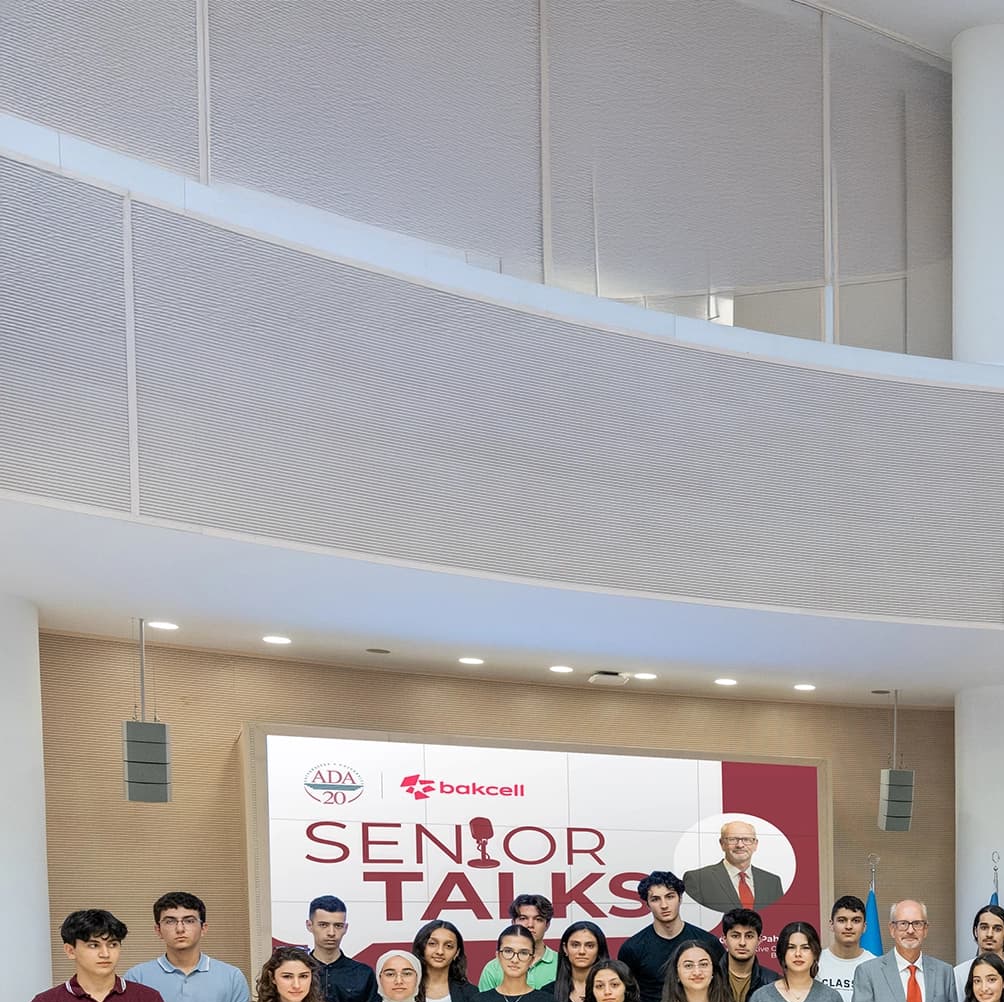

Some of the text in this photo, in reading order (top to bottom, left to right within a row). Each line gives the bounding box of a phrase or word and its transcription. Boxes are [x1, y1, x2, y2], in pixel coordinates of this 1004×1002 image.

[312, 770, 356, 784] ADA
[440, 781, 524, 797] bakcell
[322, 791, 346, 805] 20
